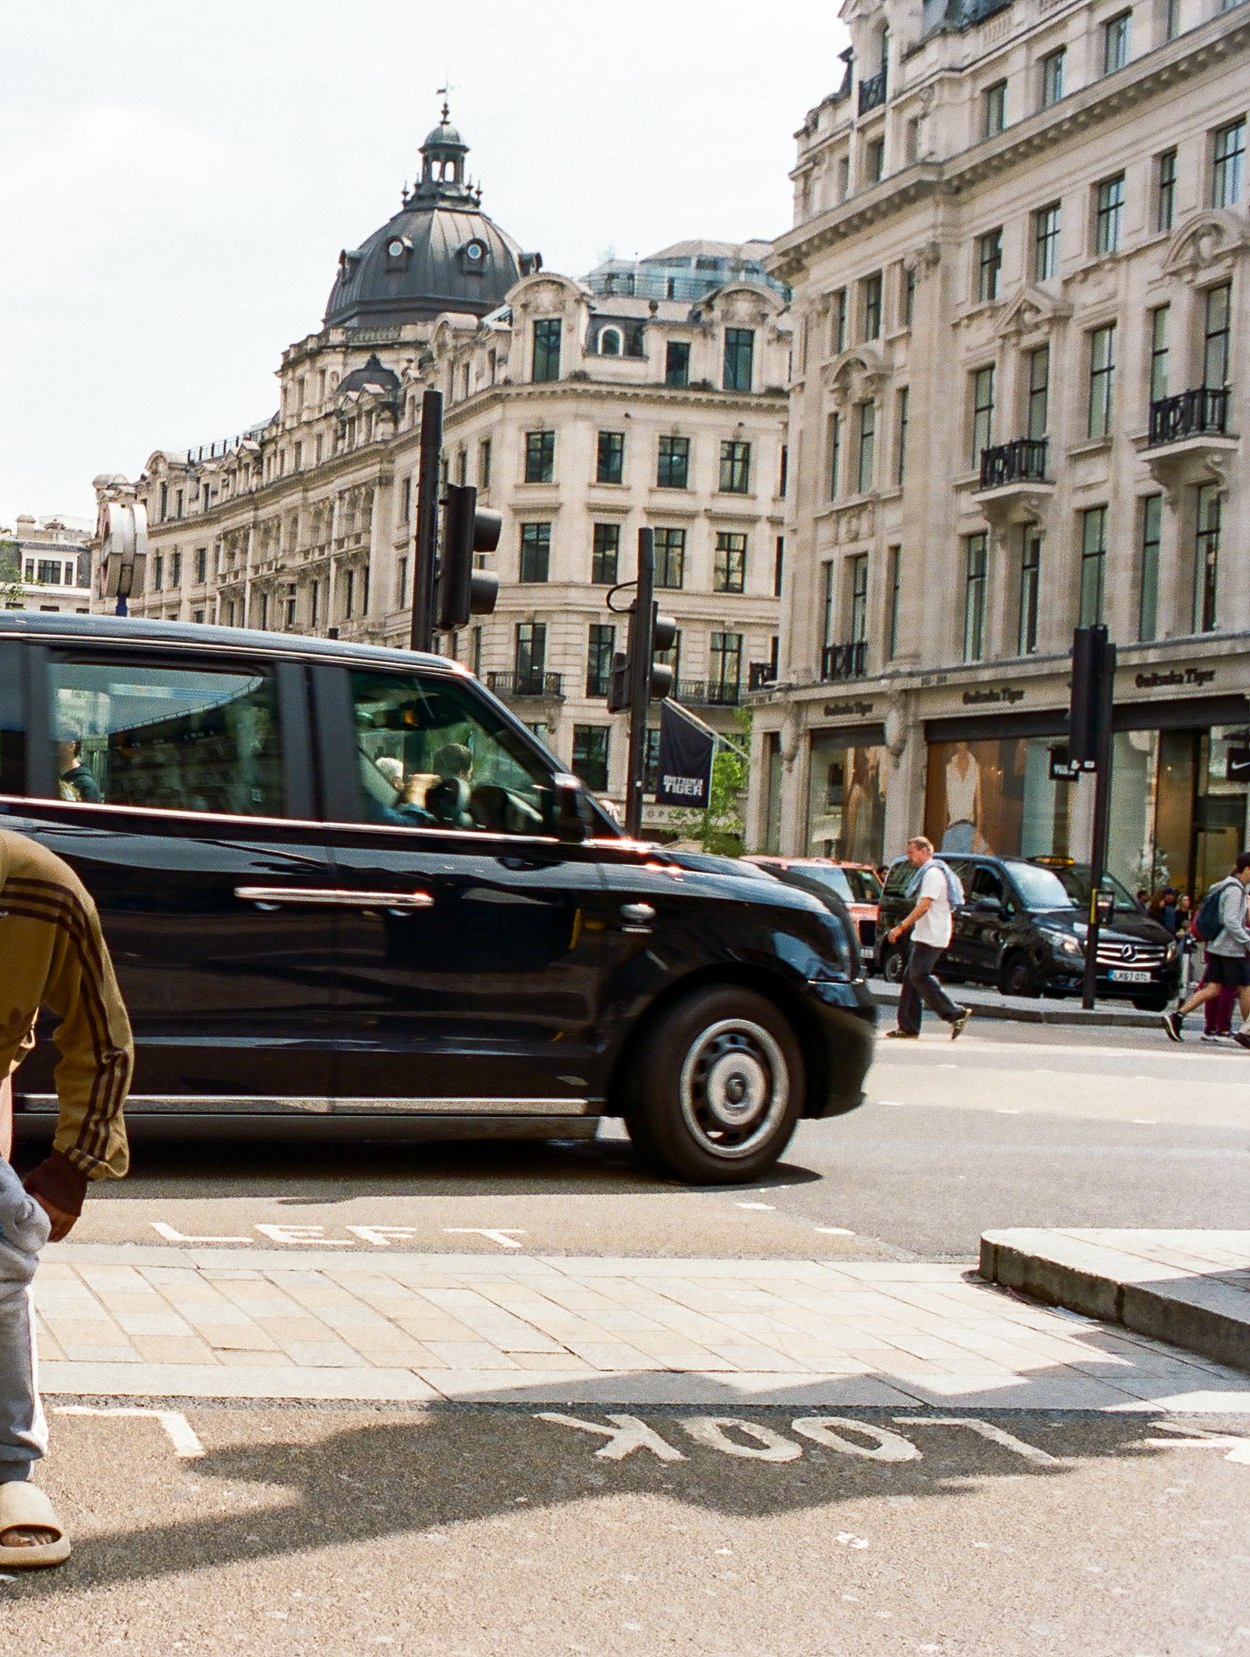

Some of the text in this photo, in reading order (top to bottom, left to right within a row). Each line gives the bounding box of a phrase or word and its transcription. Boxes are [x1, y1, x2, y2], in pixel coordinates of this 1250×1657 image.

[664, 783, 703, 796] TIGER
[150, 1221, 527, 1249] LEFT
[533, 1413, 1060, 1464] LOOK
